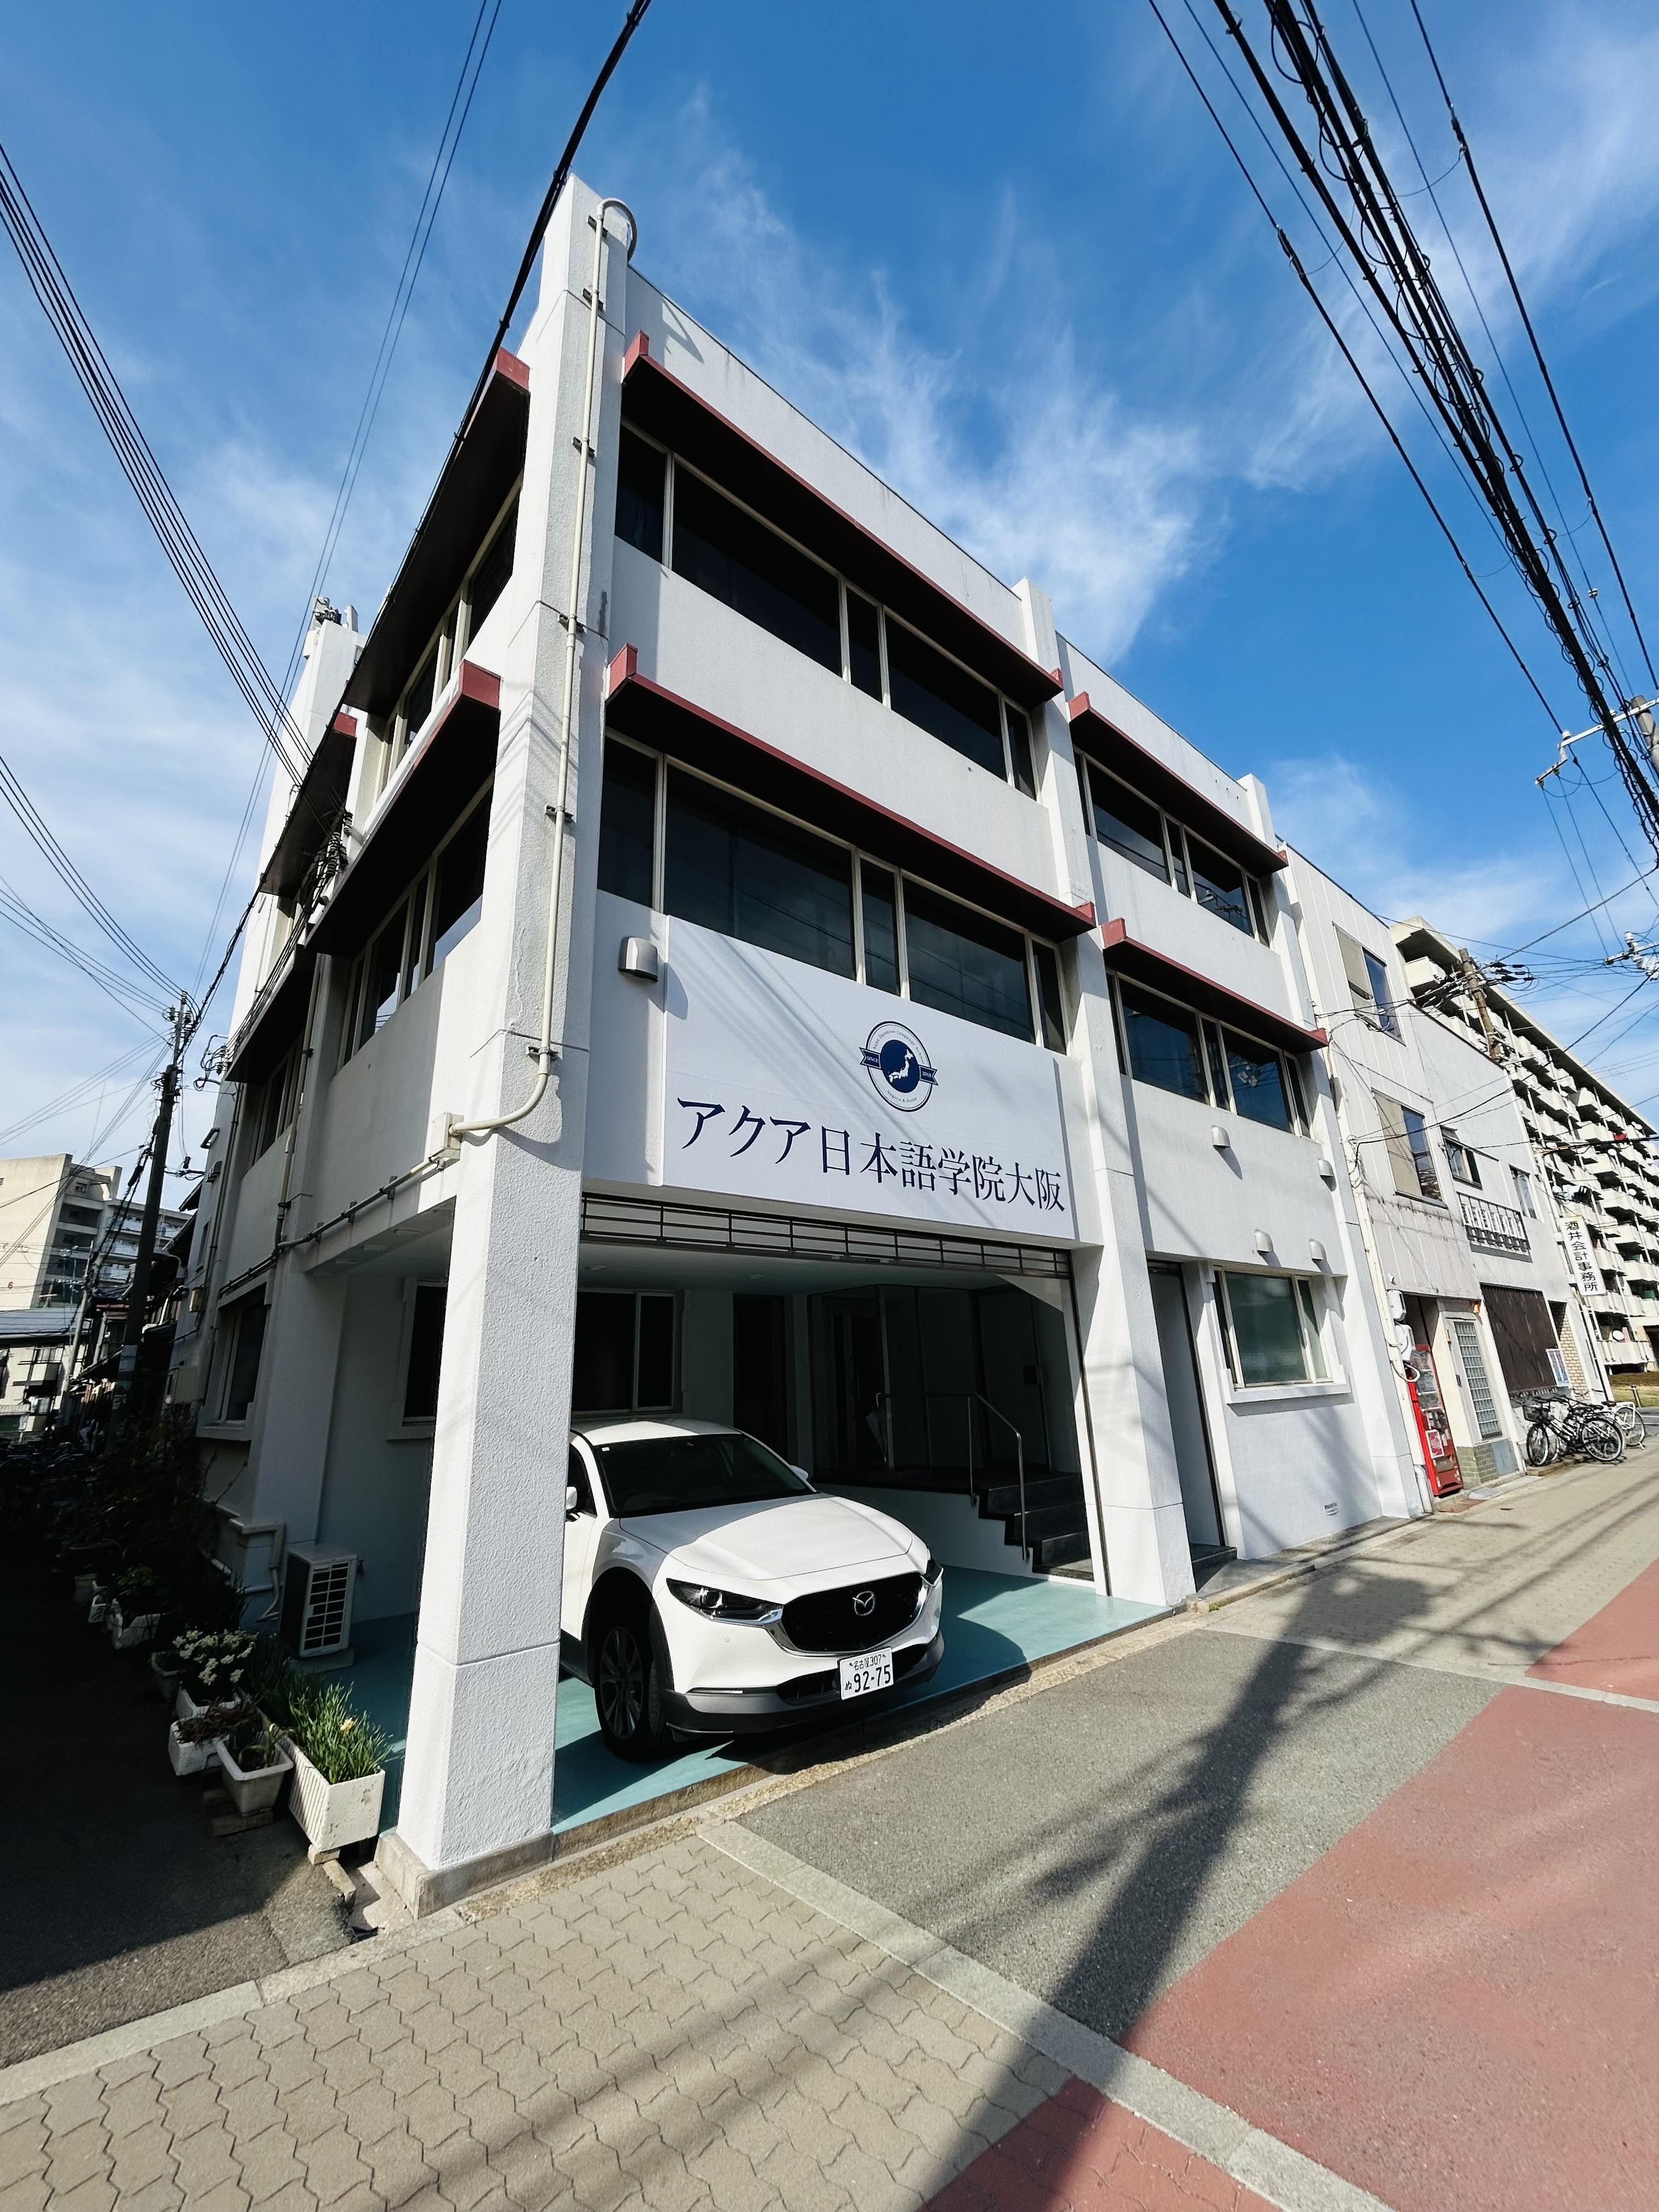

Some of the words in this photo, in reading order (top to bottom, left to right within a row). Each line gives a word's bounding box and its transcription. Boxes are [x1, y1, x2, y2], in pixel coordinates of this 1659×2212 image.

[677, 1097, 1065, 1211] アクア日本語学院大阪
[1565, 1221, 1598, 1291] 酒井会計事務所
[854, 1664, 891, 1693] 92-75
